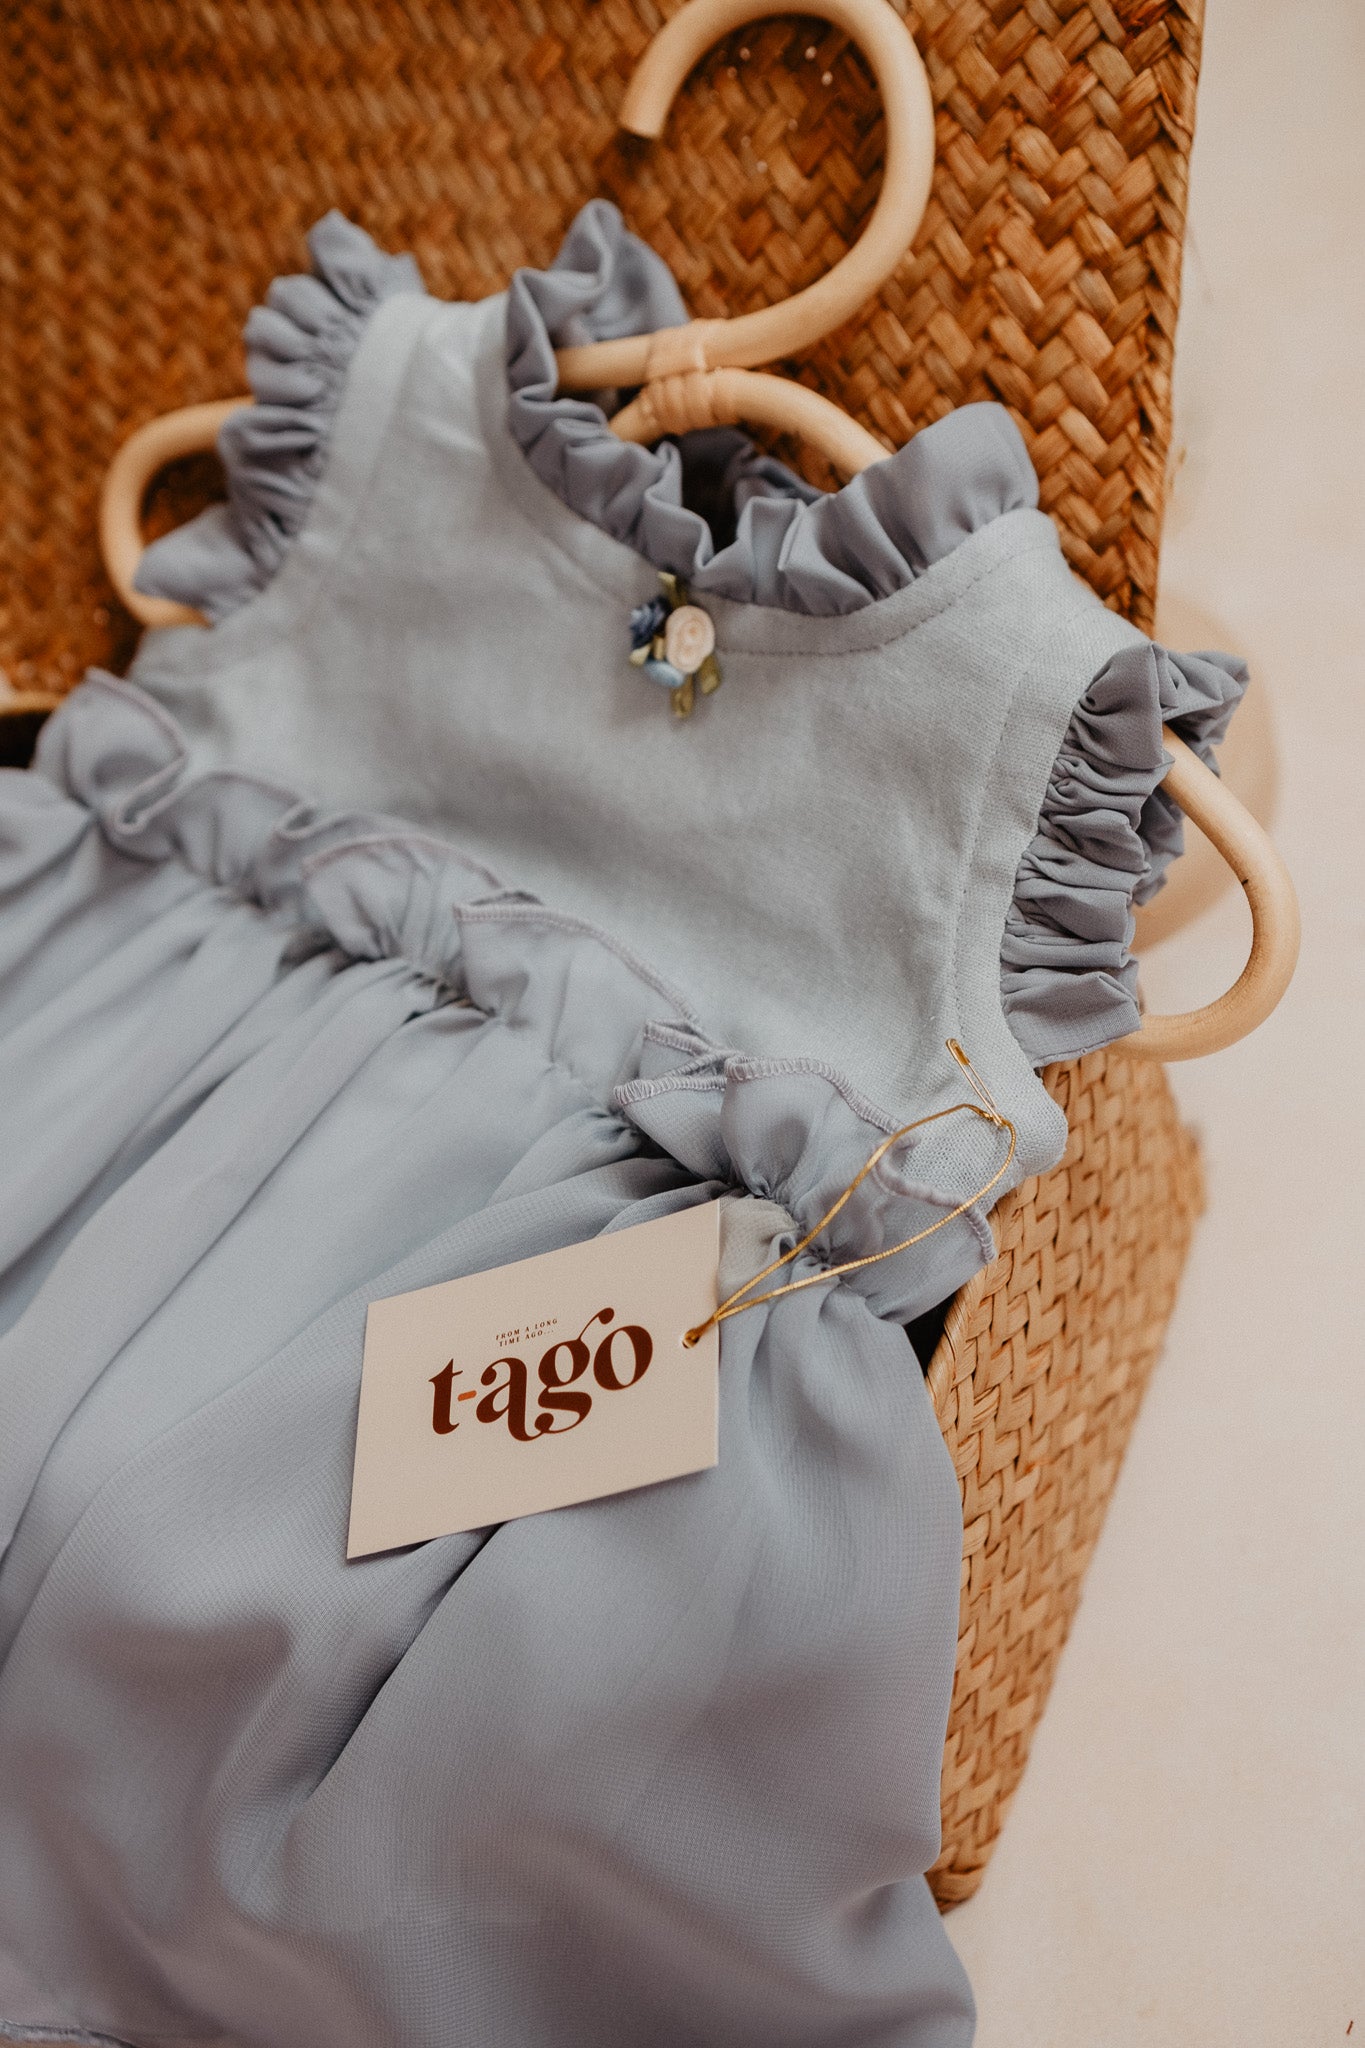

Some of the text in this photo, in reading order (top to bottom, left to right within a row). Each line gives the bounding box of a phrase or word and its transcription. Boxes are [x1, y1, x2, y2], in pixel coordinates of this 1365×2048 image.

[496, 1329, 520, 1340] FROM
[535, 1318, 557, 1329] LONG
[499, 1336, 519, 1347] TIME
[428, 1307, 653, 1442] t-ago
